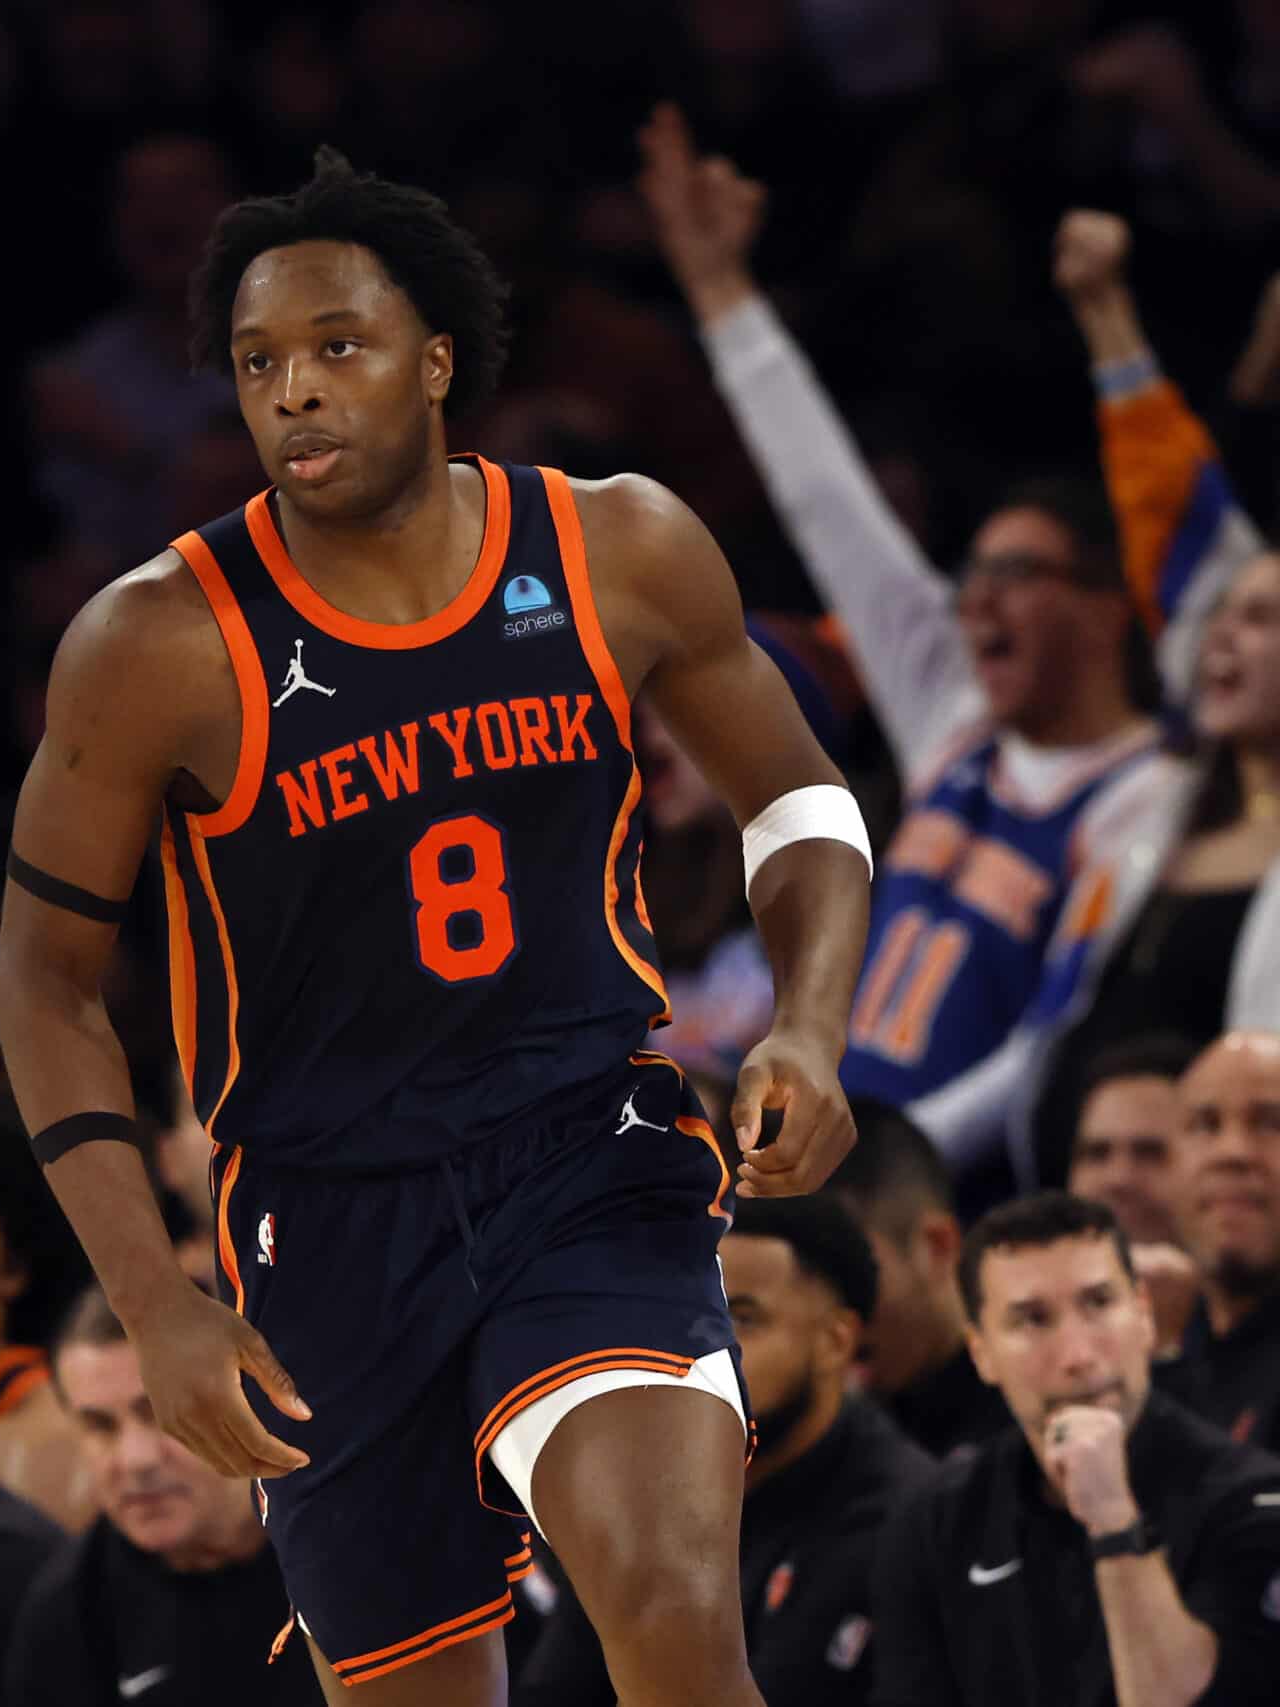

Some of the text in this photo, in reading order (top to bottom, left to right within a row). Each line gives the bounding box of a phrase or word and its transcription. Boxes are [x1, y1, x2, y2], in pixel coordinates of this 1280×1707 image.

[503, 611, 566, 637] sphere
[275, 694, 598, 838] NEW YORK
[408, 813, 517, 983] 8
[848, 905, 968, 1066] 11
